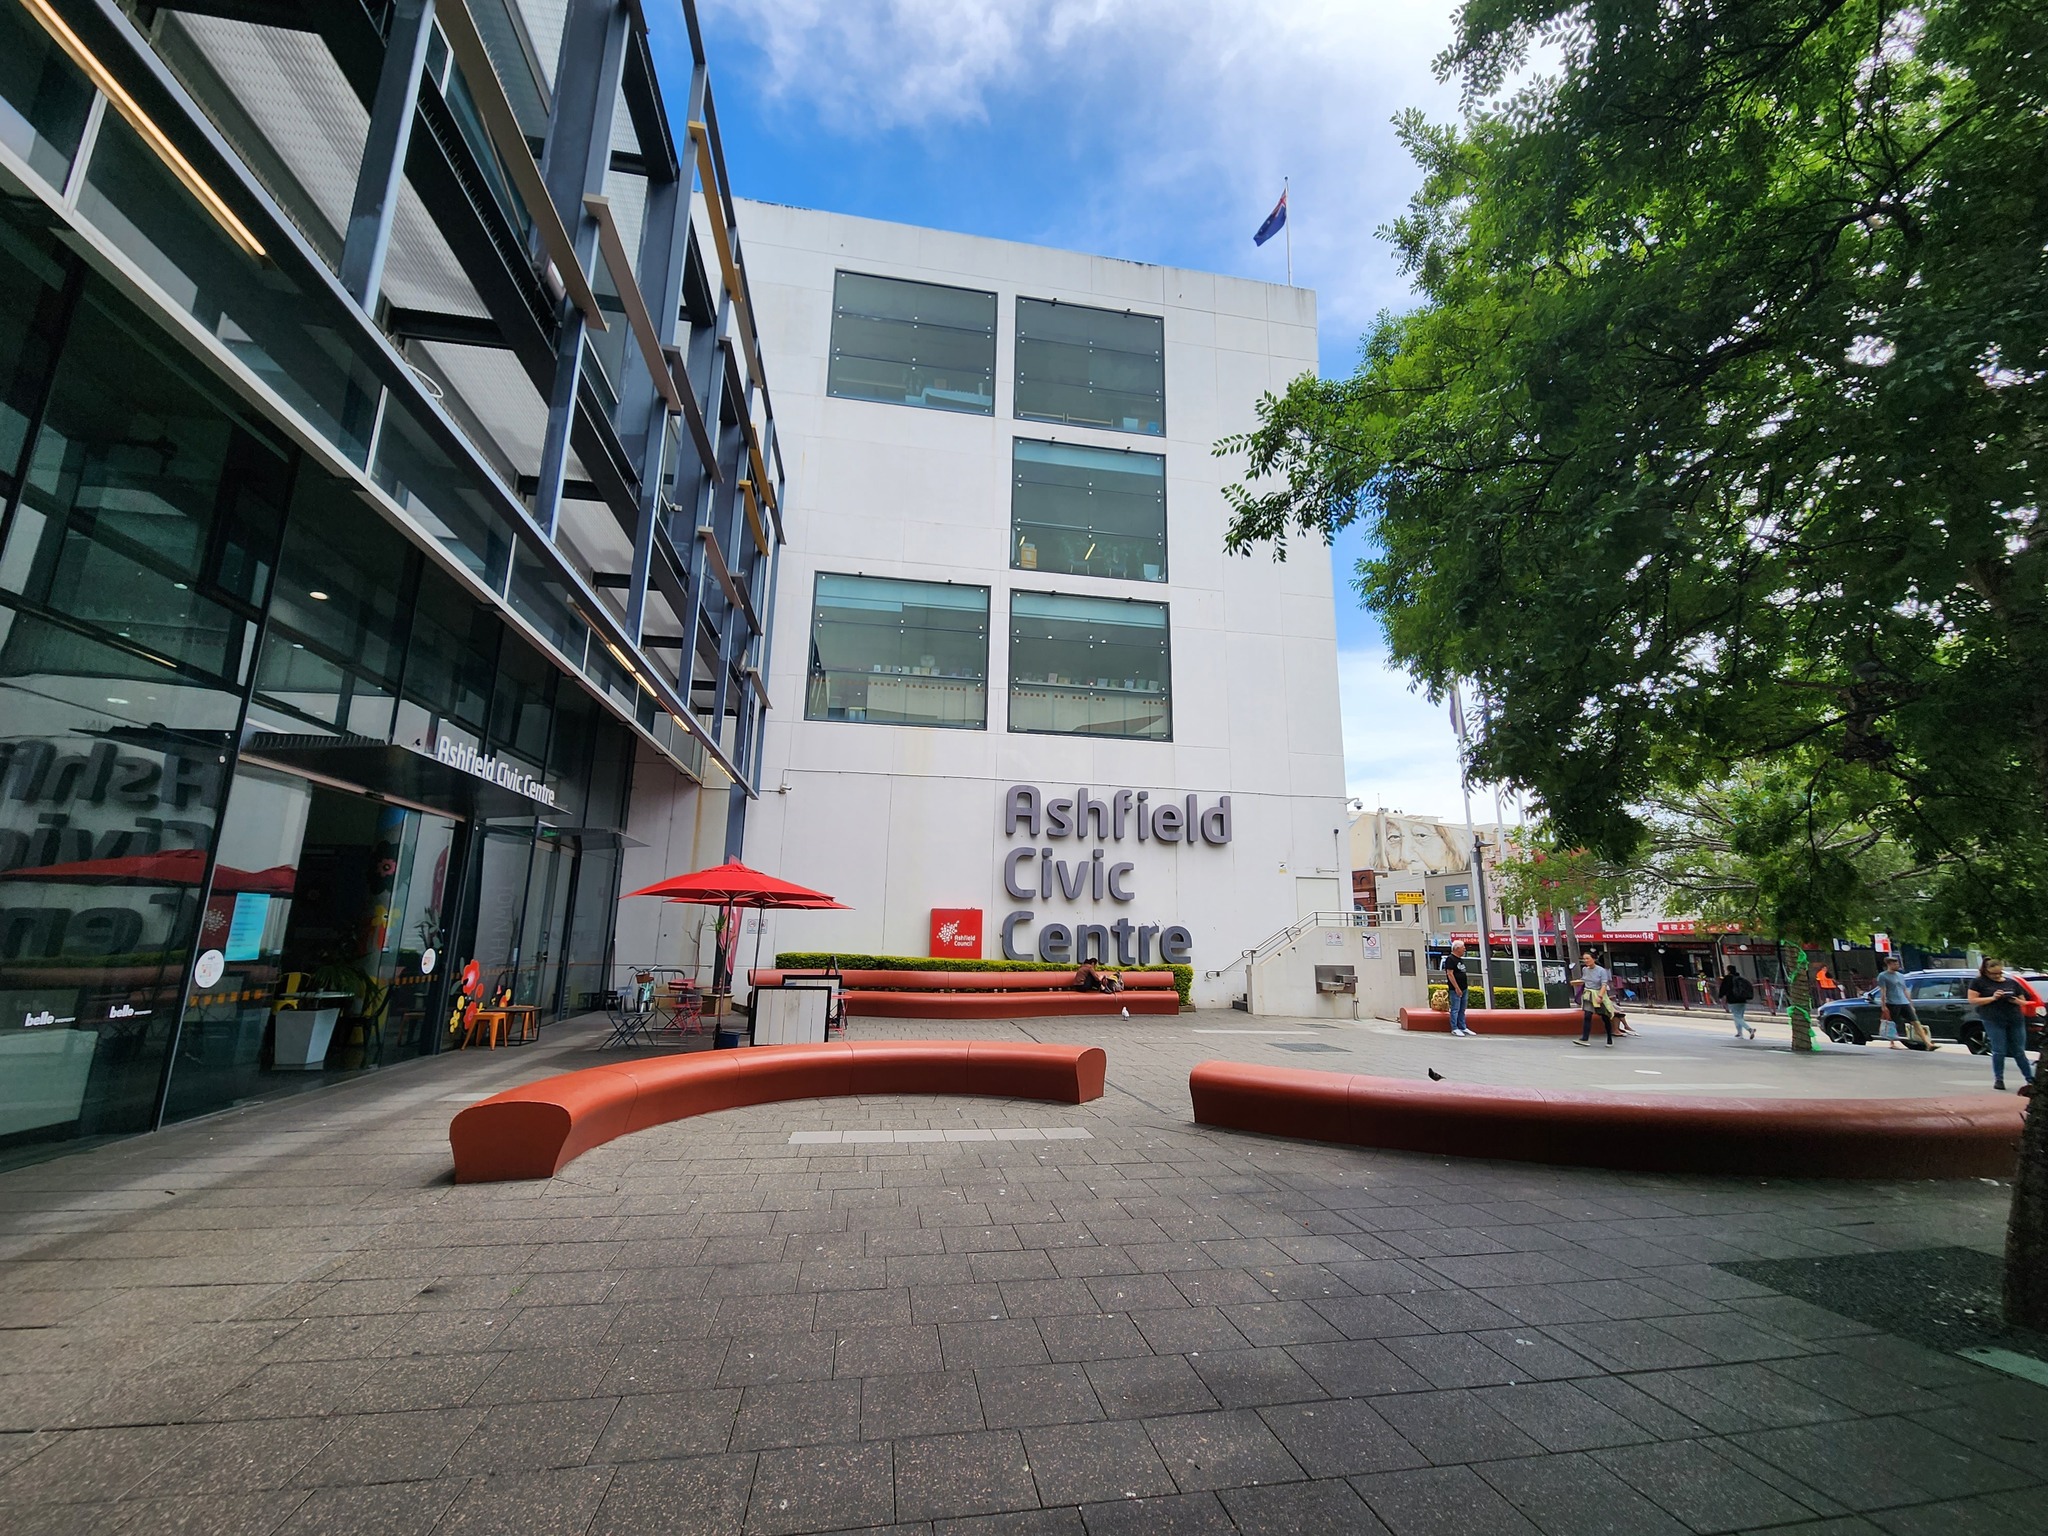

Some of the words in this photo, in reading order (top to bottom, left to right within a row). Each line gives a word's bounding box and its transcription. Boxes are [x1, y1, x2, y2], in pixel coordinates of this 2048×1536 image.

[437, 735, 496, 783] Ashfield
[496, 762, 524, 793] Civic
[524, 774, 555, 806] Centre
[1005, 784, 1232, 845] Ashfield
[1004, 846, 1136, 901] Civic
[954, 934, 976, 942] Ashfield
[1001, 910, 1193, 966] Centre
[24, 1010, 55, 1027] belle
[109, 1004, 135, 1018] belle
